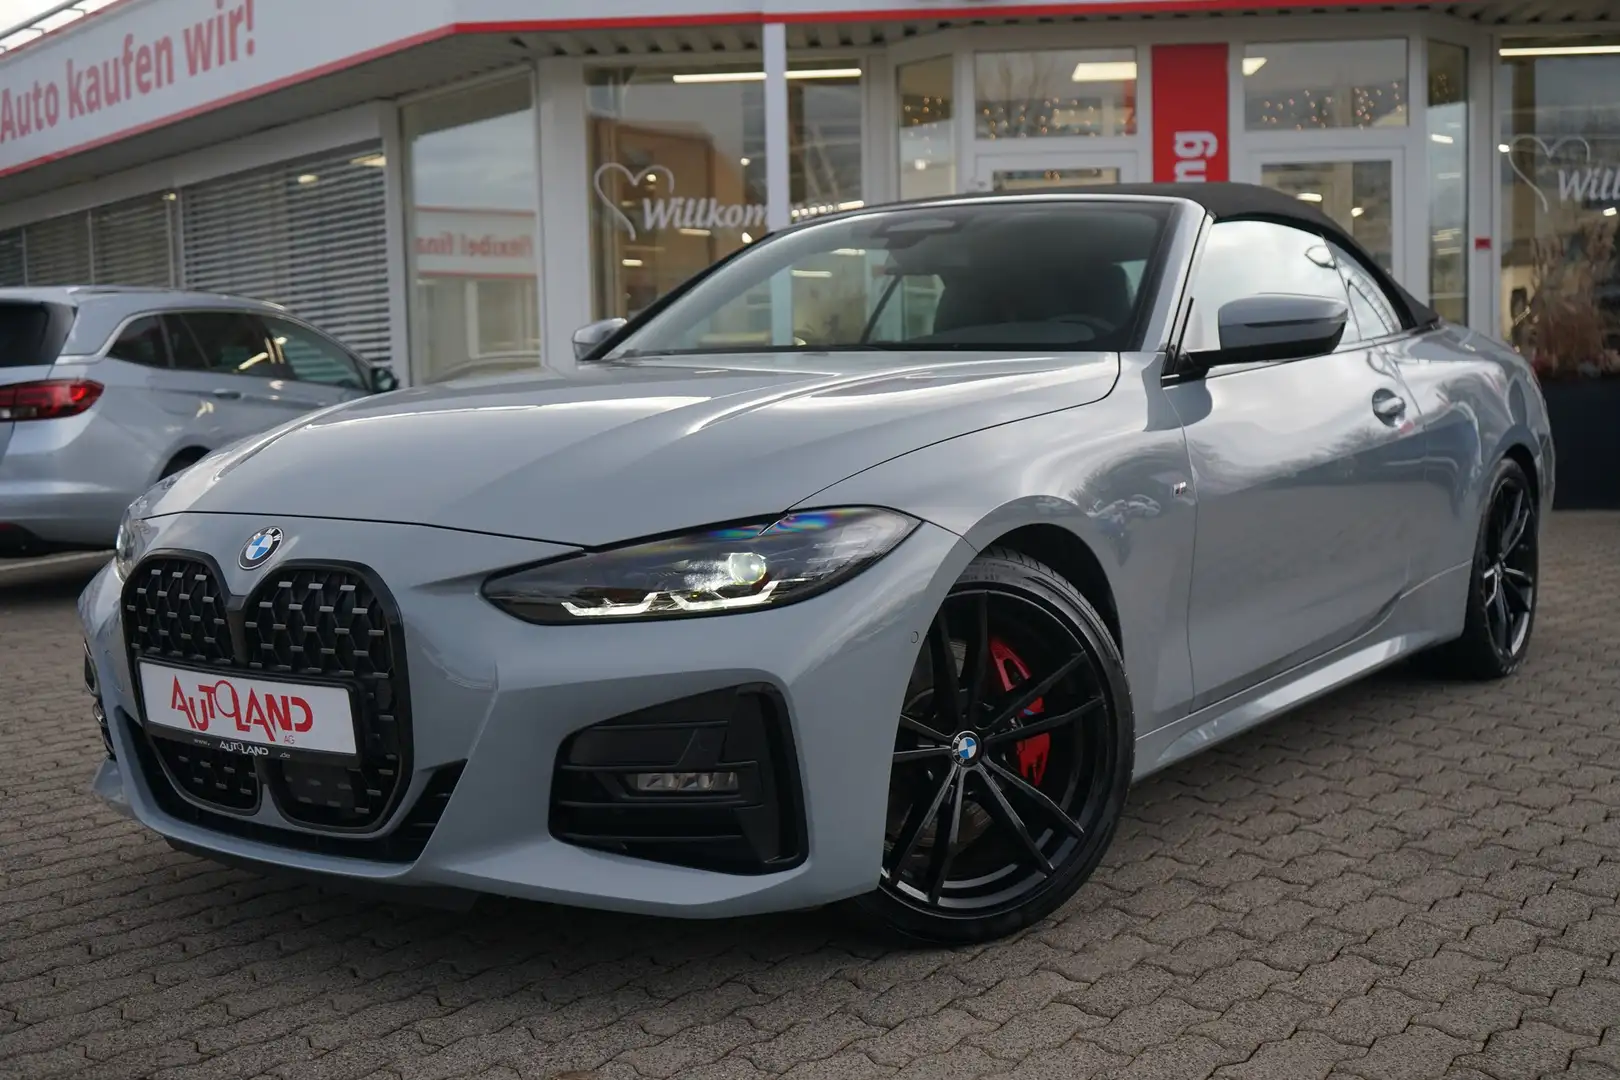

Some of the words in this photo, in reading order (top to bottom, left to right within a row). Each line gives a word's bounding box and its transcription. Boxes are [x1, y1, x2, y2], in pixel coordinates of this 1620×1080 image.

[0, 80, 59, 144] Auto
[66, 33, 174, 120] kaufen
[183, 0, 256, 77] wir!
[171, 675, 313, 742] AUTOLAND
[220, 740, 269, 757] AUTOLAND
[283, 734, 296, 745] AG
